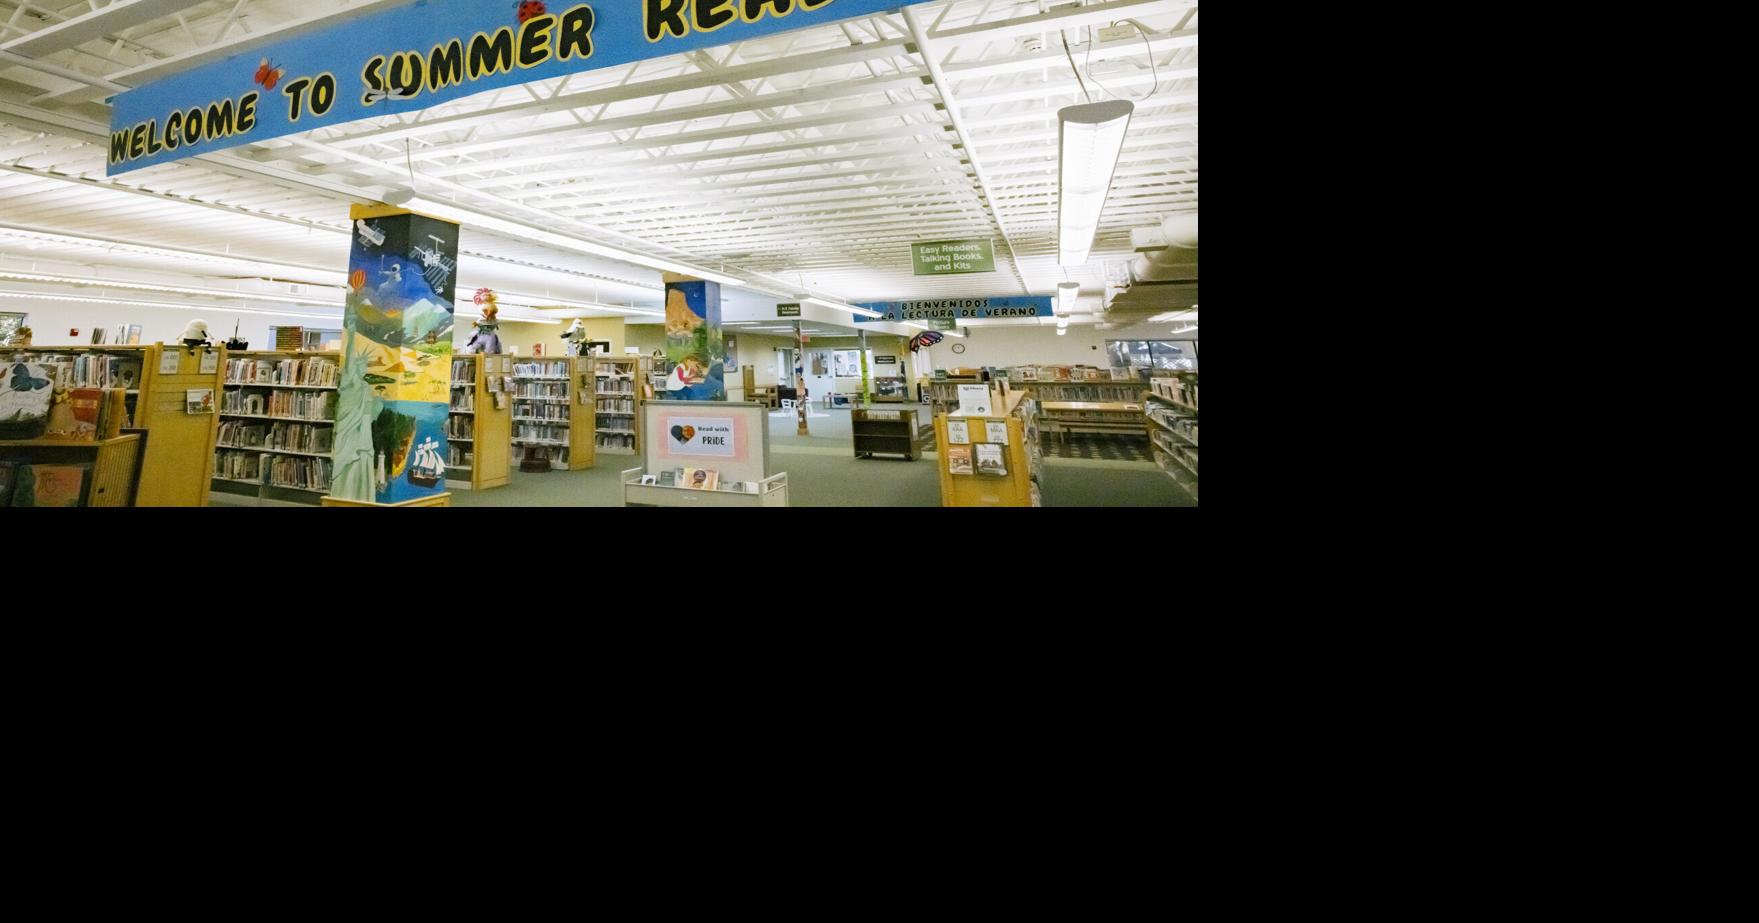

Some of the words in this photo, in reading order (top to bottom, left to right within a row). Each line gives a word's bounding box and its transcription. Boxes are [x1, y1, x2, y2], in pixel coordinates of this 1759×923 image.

[110, 91, 259, 165] WELCOME
[283, 73, 336, 121] TO
[361, 4, 595, 106] SUMMER
[920, 246, 940, 254] Easy
[920, 255, 951, 263] Talking
[901, 299, 988, 310] BIENVENIDOS
[901, 309, 955, 319] LECTURA
[961, 309, 977, 317] DE
[985, 307, 1037, 316] VERANO
